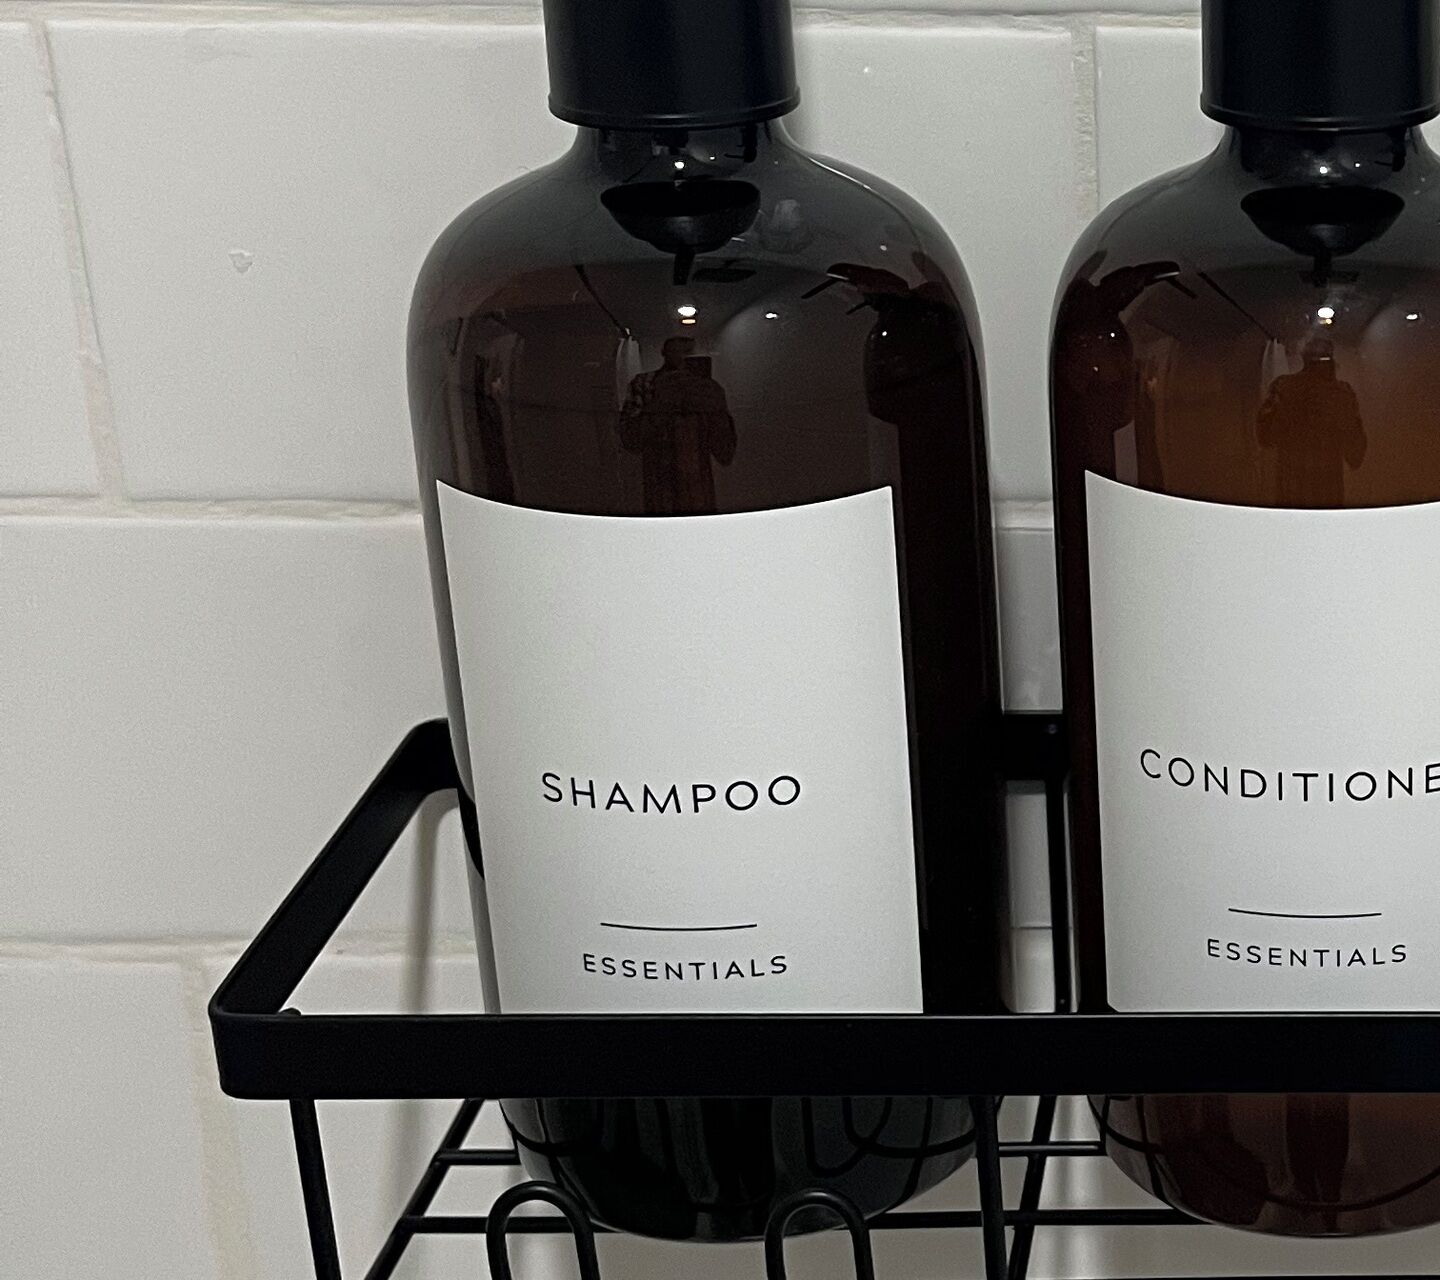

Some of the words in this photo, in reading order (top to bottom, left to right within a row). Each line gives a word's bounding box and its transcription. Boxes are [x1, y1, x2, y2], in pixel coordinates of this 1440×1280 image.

[541, 771, 802, 815] SHAMPOO
[582, 952, 789, 981] ESSENTIALS
[1206, 937, 1408, 968] ESSENTIALS
